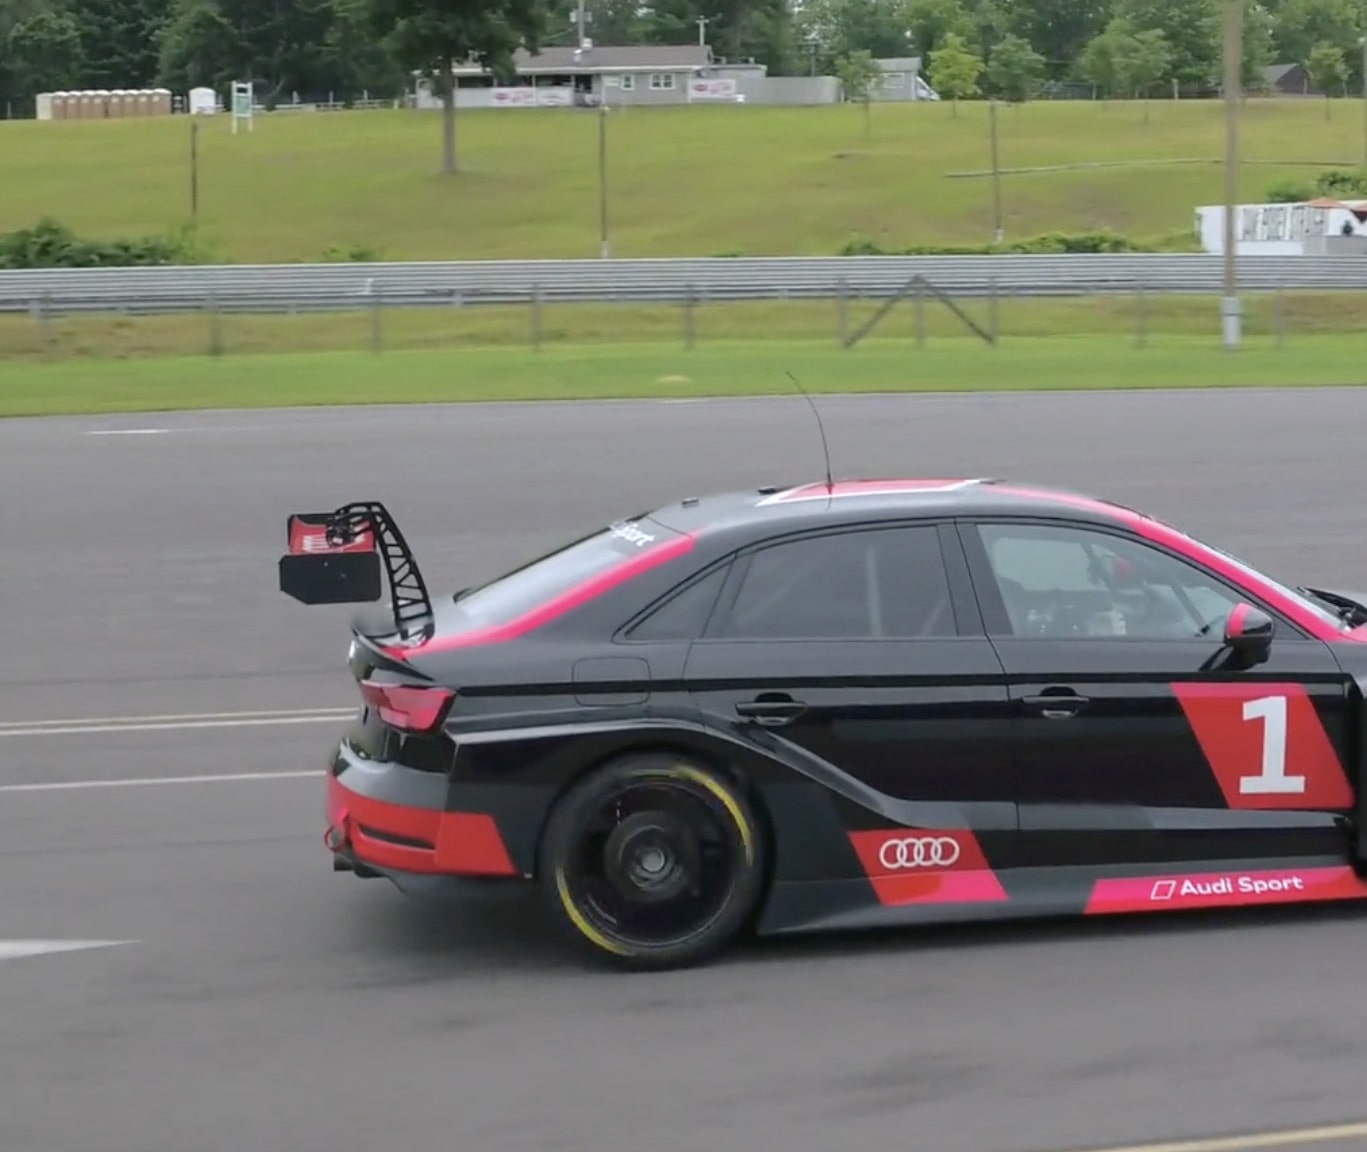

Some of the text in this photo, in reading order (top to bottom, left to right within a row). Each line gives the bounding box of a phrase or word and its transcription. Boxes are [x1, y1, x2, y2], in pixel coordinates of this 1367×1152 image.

[1239, 695, 1306, 794] 1
[1180, 876, 1305, 896] Audi Sport
